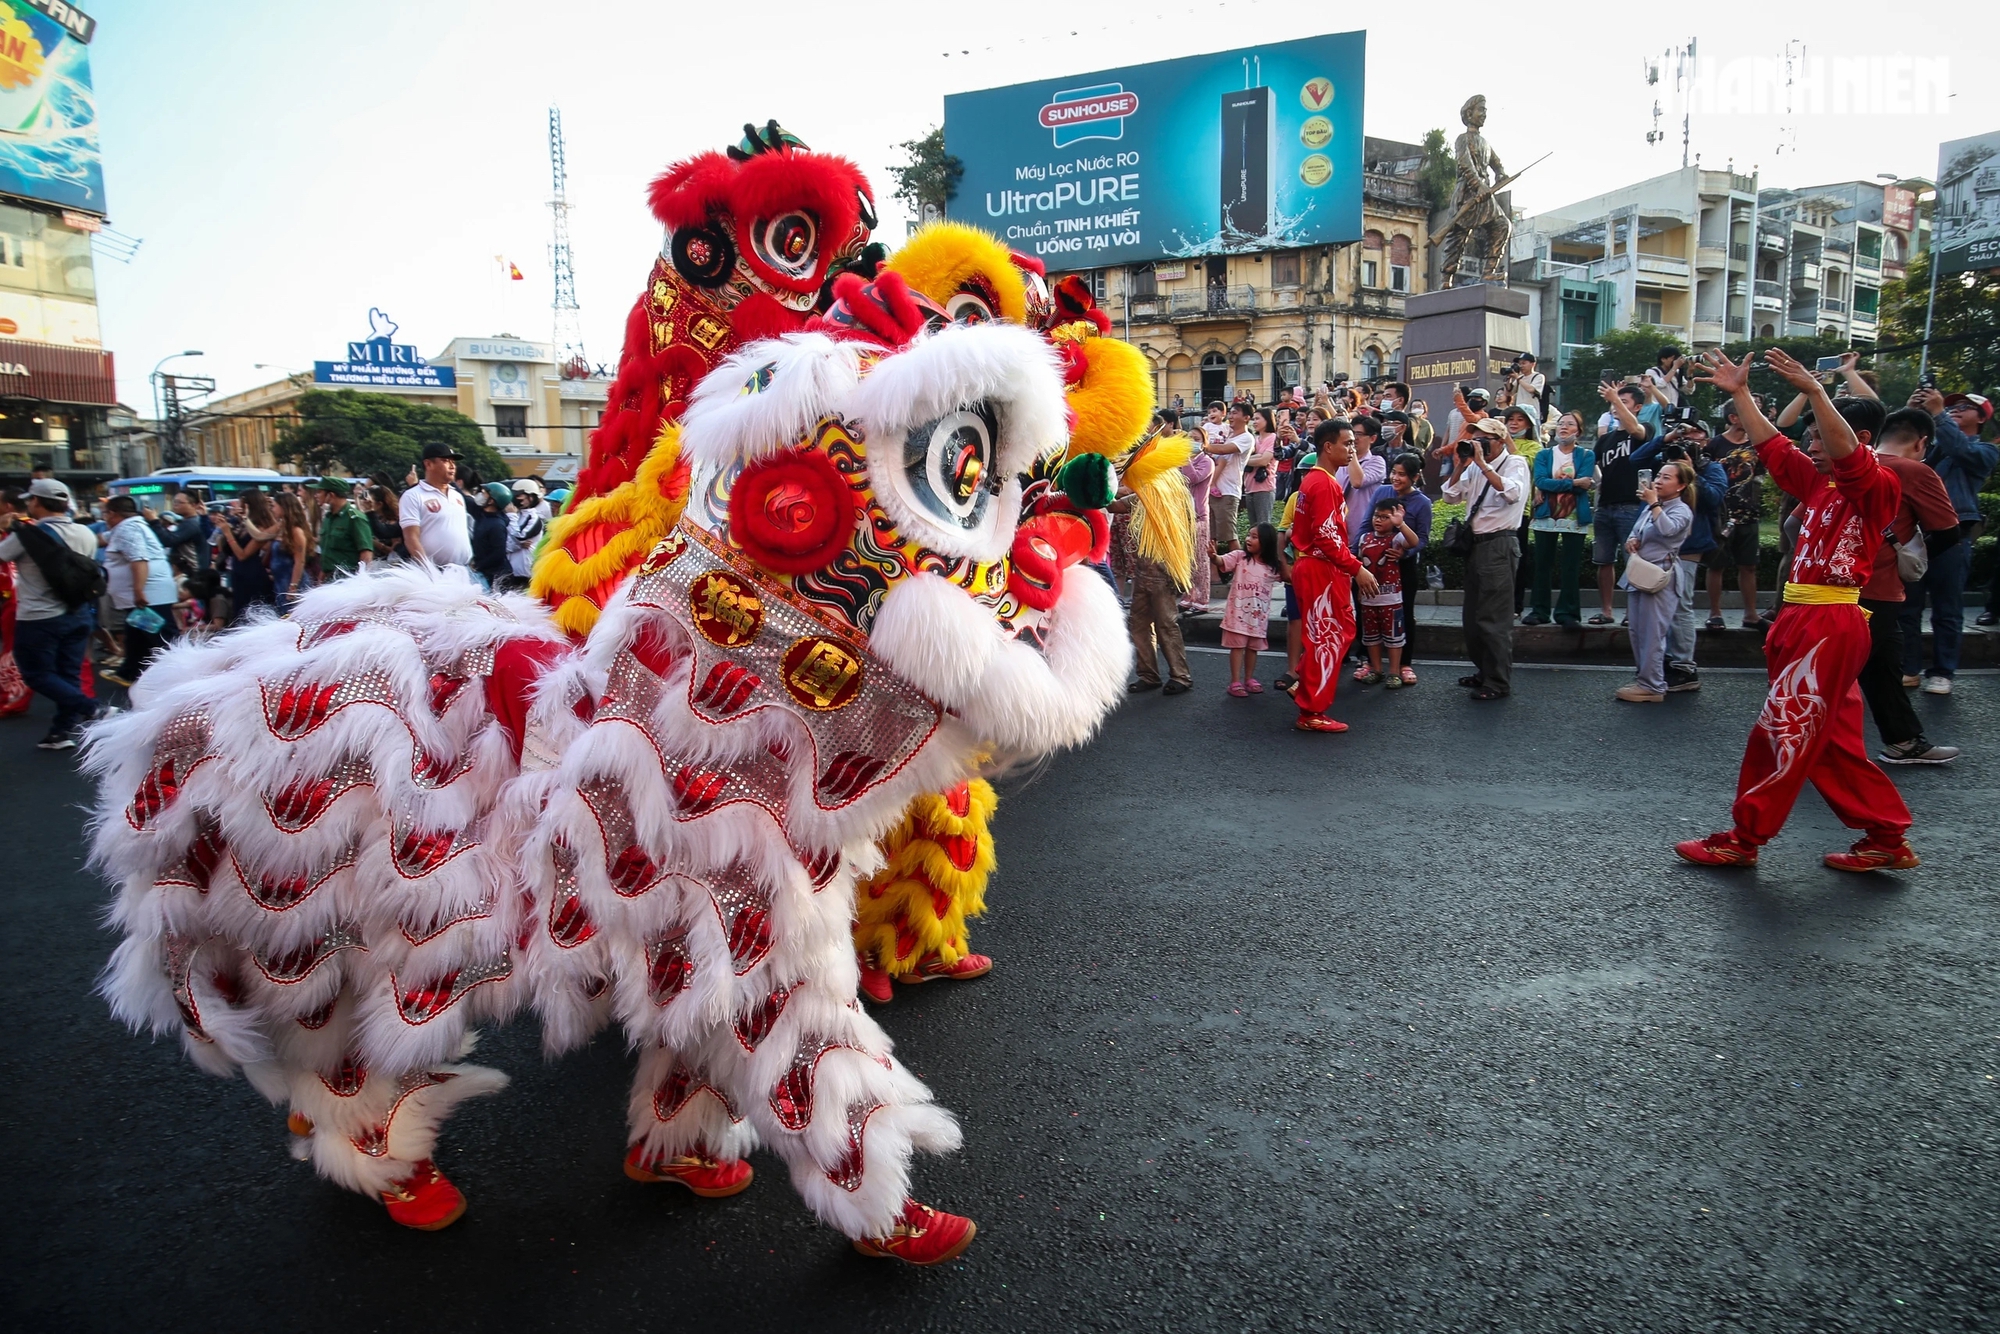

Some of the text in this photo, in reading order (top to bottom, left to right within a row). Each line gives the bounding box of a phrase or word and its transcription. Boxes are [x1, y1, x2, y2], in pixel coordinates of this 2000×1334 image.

[1015, 151, 1140, 181] Máy Lọc Nước RO
[986, 173, 1140, 217] UltraPURE
[1006, 207, 1141, 239] Chuẩn TINH KHIẾT
[1035, 230, 1140, 255] UỐNG TẠI VÒI
[424, 377, 441, 386] GIA
[1410, 357, 1476, 380] PHAN ĐÌNH PHÙNG
